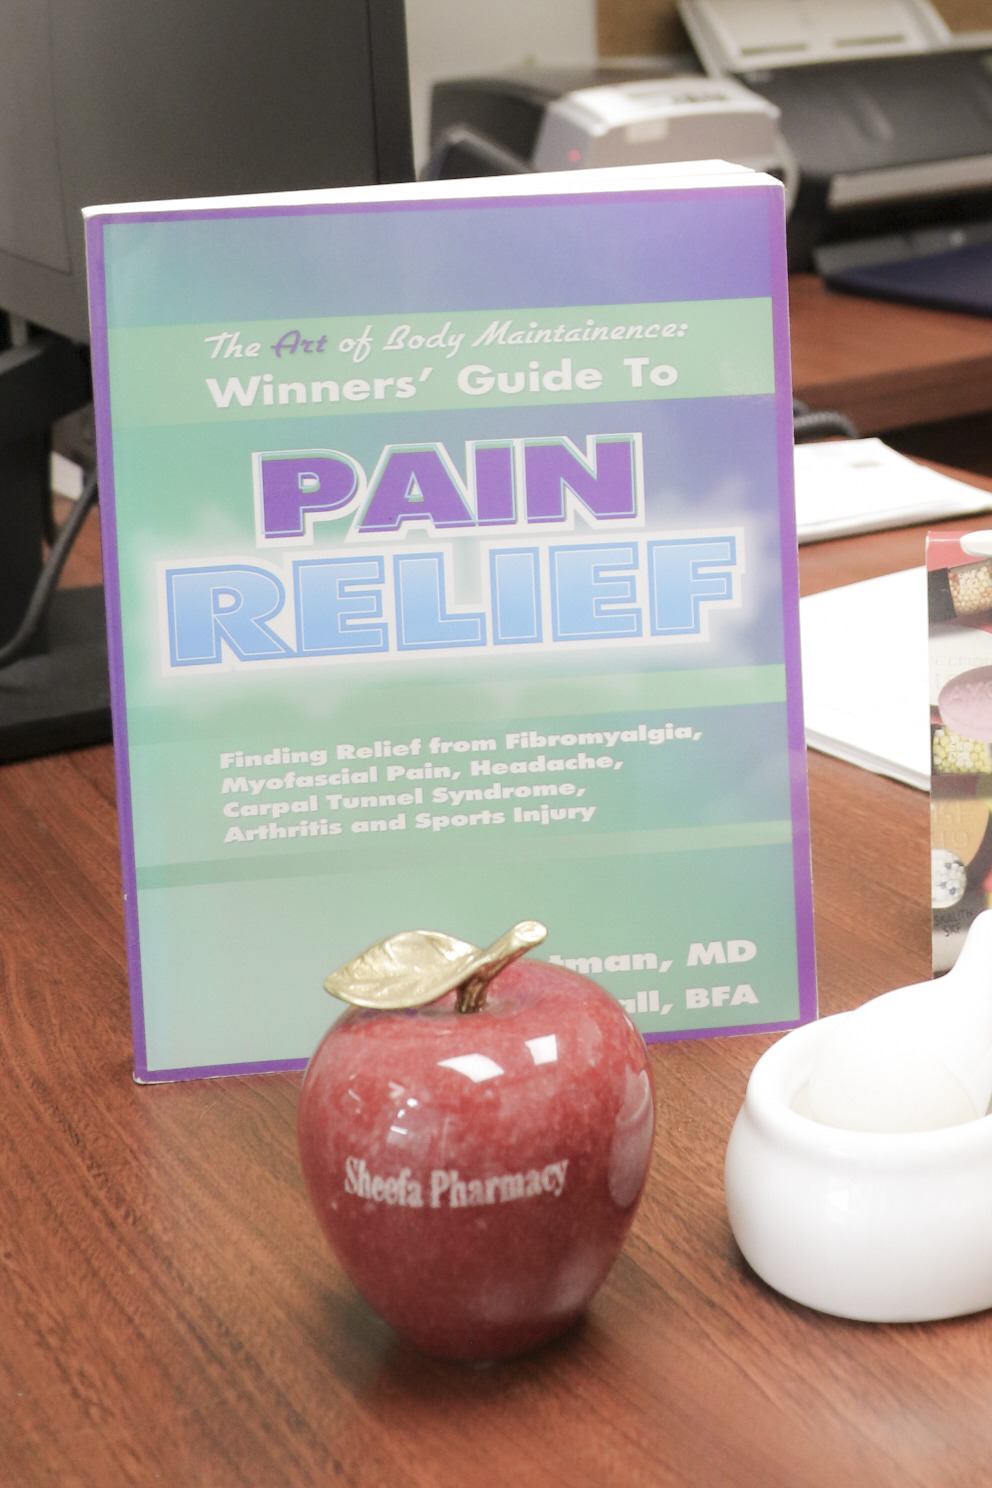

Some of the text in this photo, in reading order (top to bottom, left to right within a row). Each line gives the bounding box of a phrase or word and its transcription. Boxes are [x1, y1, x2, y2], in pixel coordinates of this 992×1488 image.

[204, 319, 688, 363] The Art of Body Maintainence:
[457, 358, 603, 395] Guide
[623, 357, 678, 387] To
[253, 433, 644, 546] PAIN
[162, 530, 740, 672] RELIEF
[220, 722, 703, 769] Finding Relief from Fibromyalgia,
[221, 752, 624, 795] Myofascial Pain, Headache,
[223, 782, 587, 818] Carpal Tunnel Syndrome,
[223, 804, 597, 843] Arthritis and Sports Injury
[686, 939, 758, 967] MD
[685, 984, 760, 1010] BFA
[345, 1155, 569, 1209] Sheefa Pharmacy
